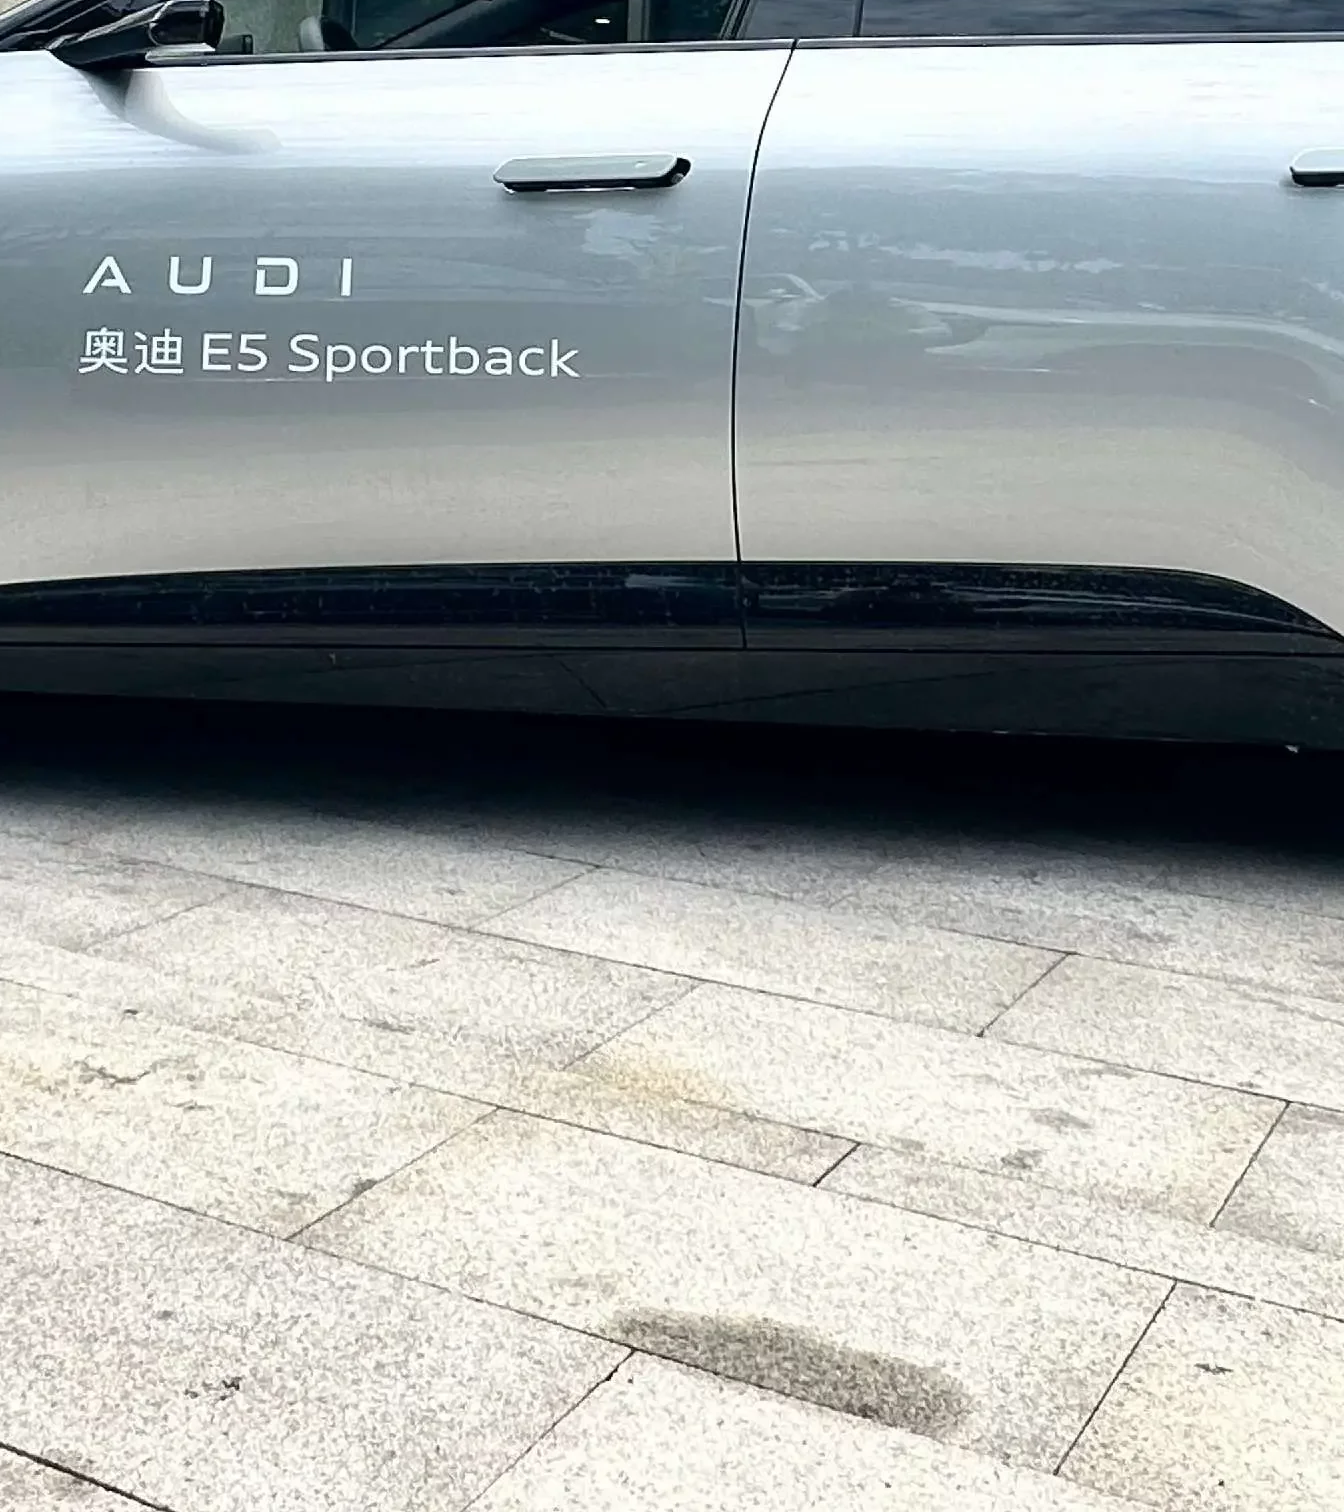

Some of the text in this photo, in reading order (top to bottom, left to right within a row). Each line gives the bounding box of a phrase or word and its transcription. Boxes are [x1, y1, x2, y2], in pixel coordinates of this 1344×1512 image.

[82, 255, 353, 297] AUDI
[77, 326, 581, 382] 奥迪 E5 Sportback
